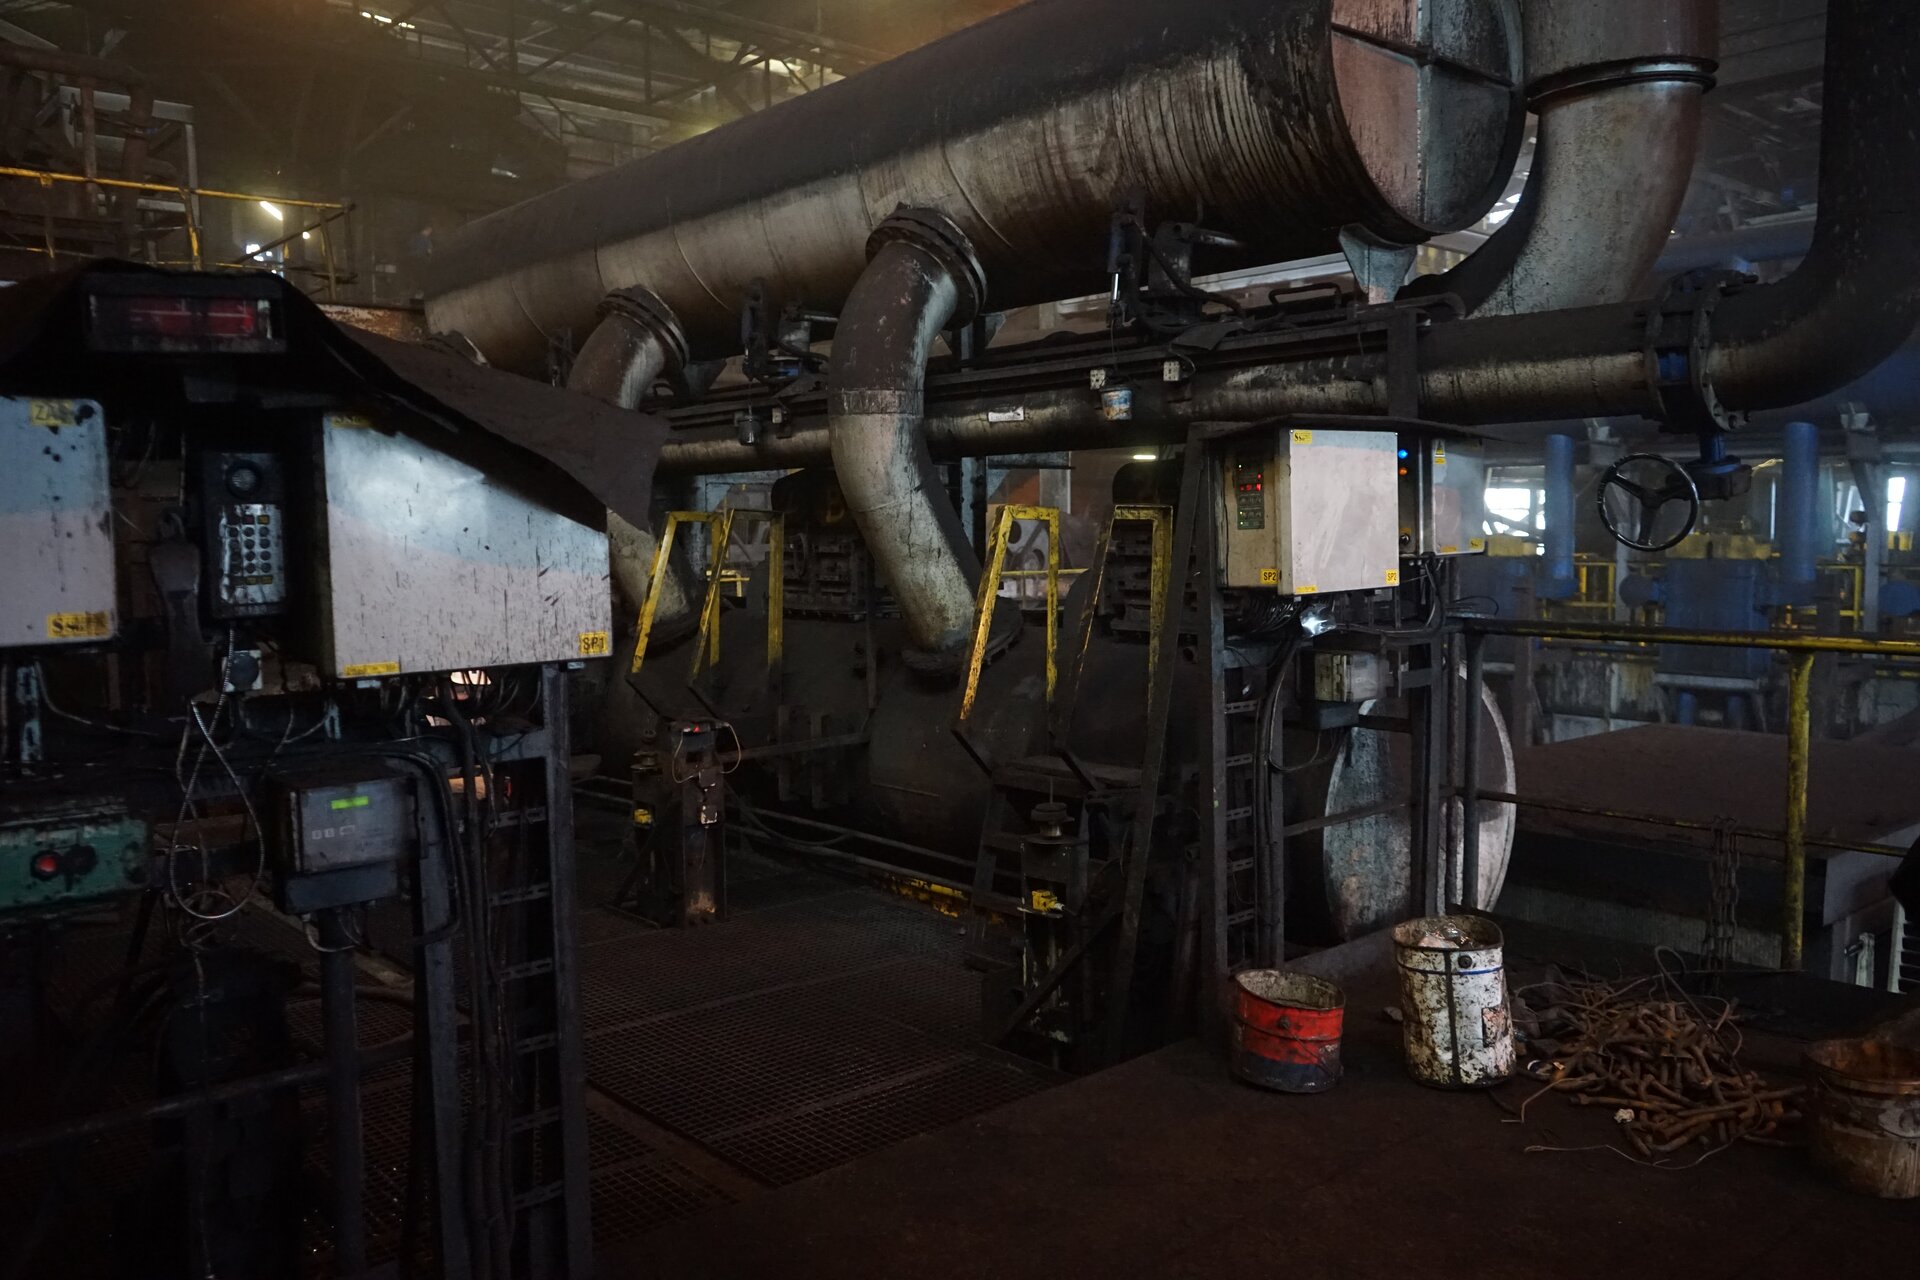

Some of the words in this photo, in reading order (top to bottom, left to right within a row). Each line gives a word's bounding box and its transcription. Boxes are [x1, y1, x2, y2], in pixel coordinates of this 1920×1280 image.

[1263, 571, 1277, 581] SP2
[1387, 572, 1397, 582] SP2
[582, 636, 605, 651] SP1
